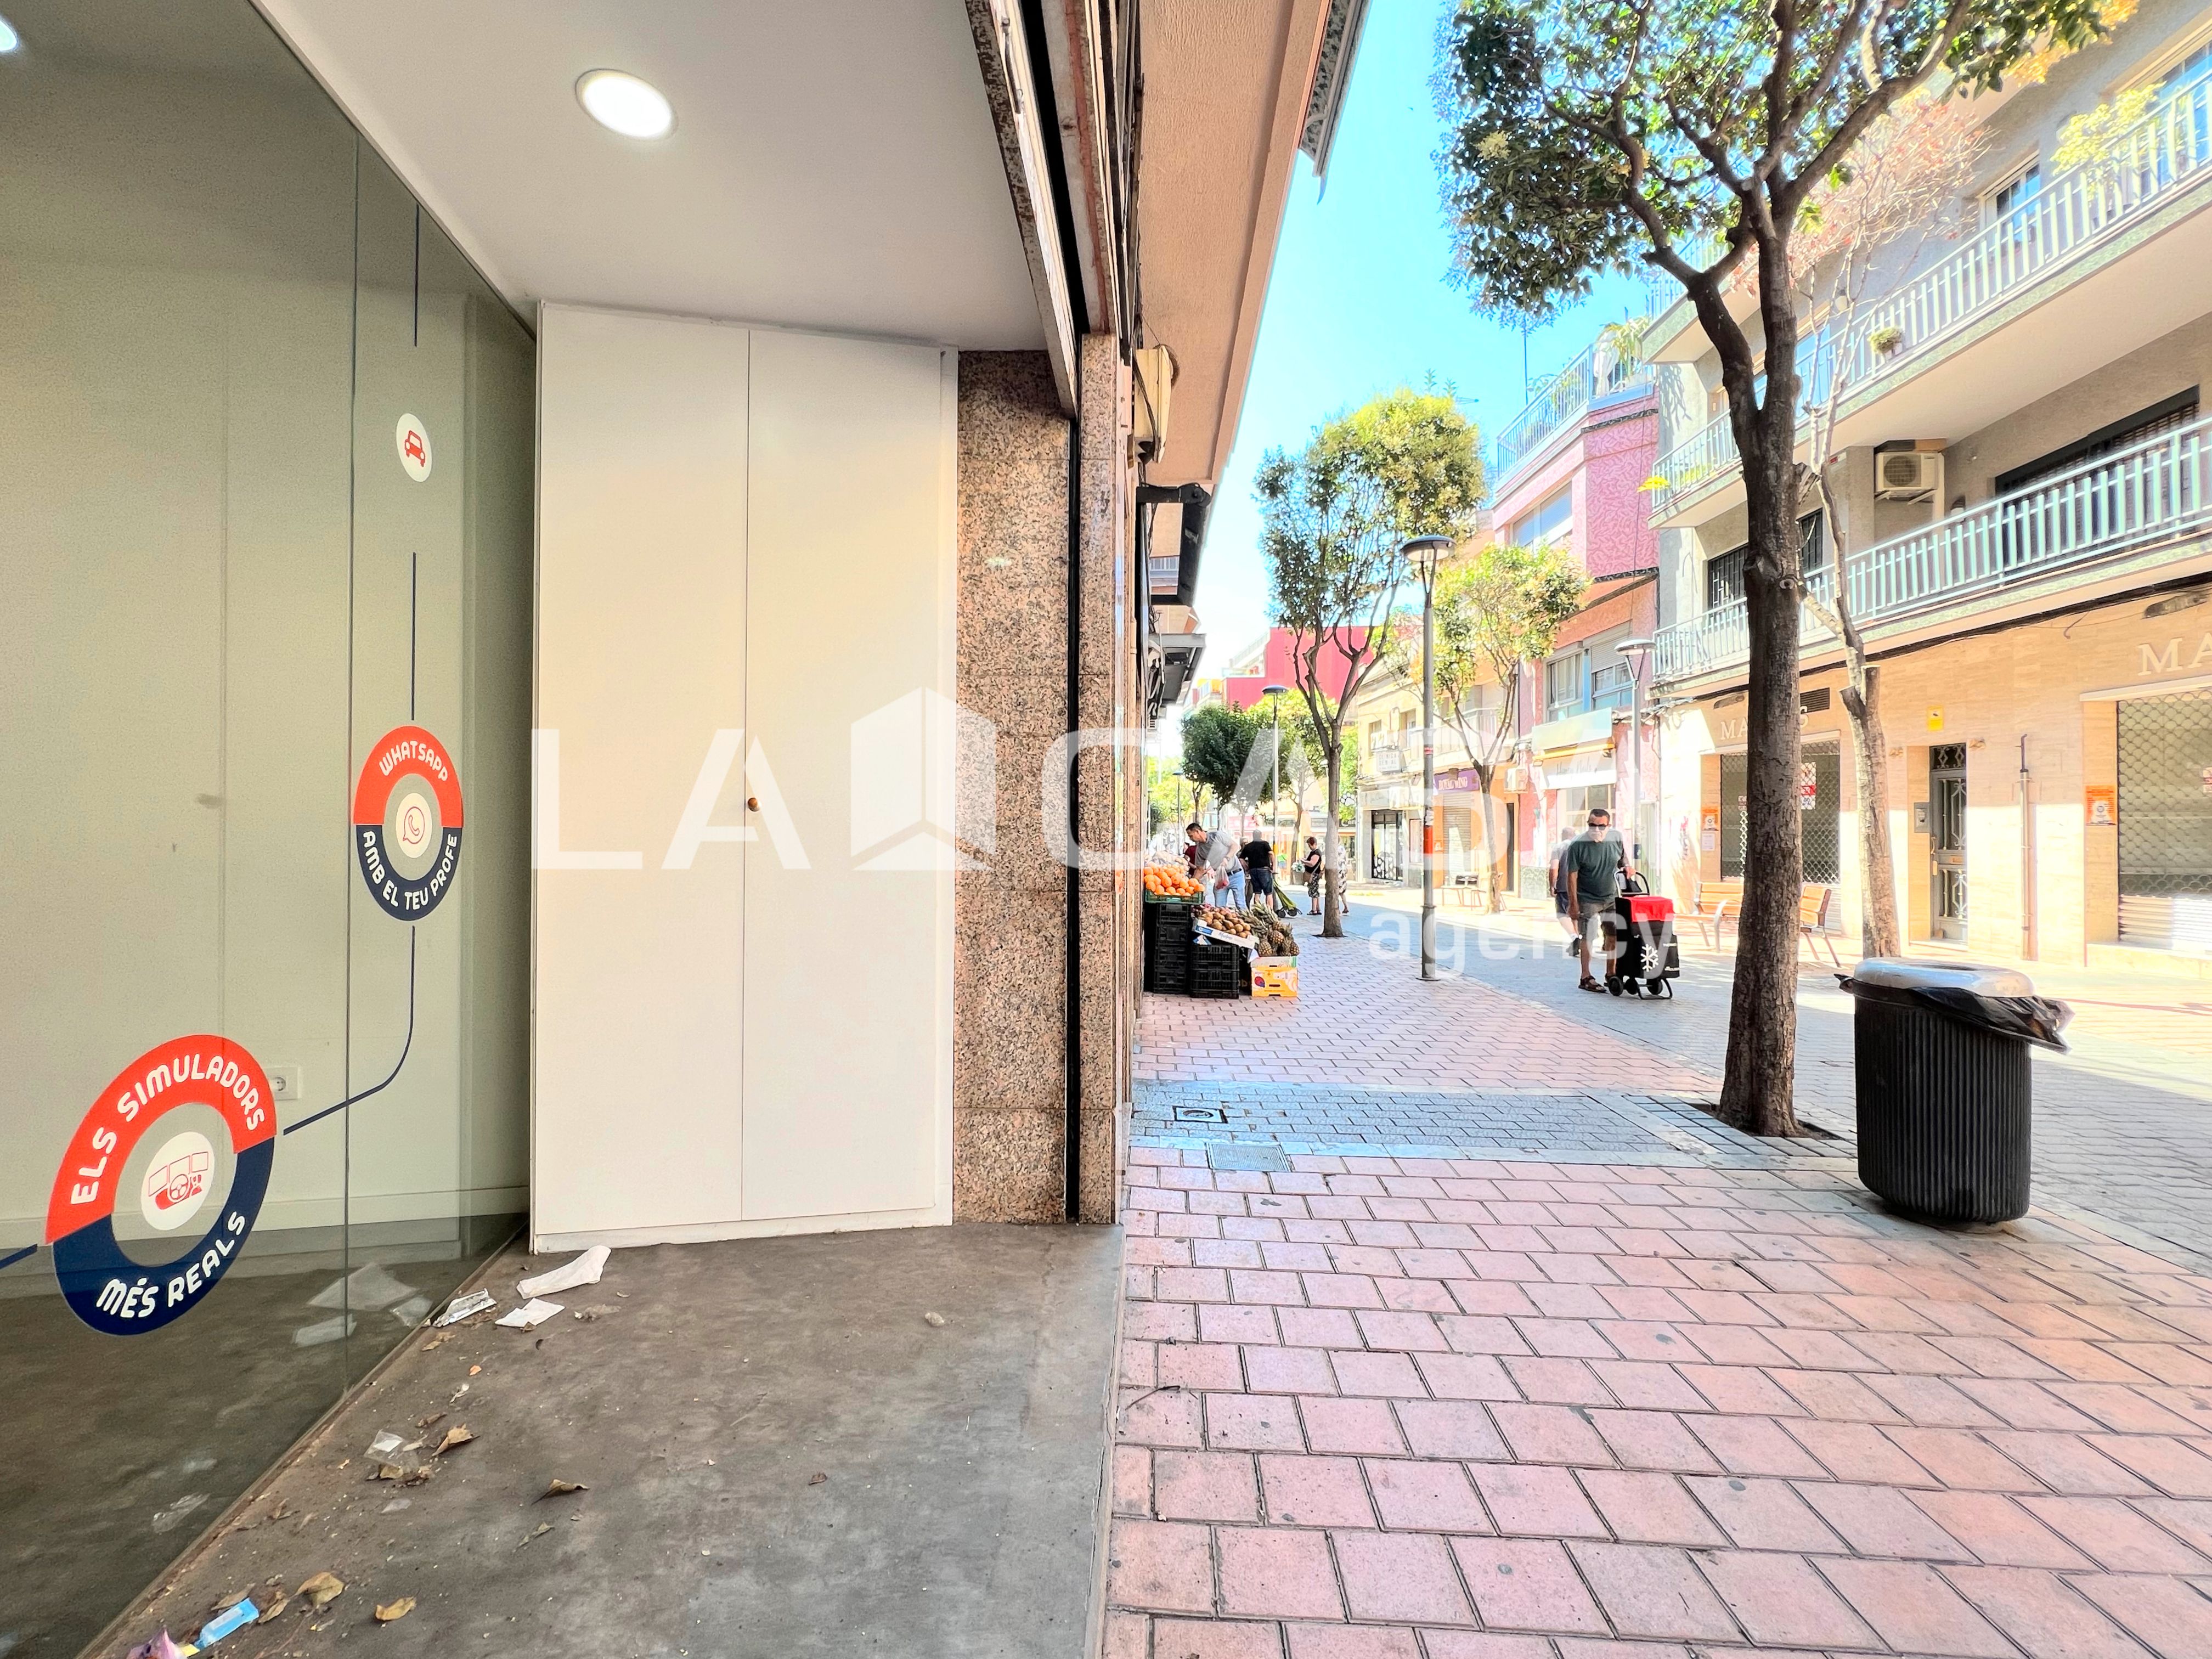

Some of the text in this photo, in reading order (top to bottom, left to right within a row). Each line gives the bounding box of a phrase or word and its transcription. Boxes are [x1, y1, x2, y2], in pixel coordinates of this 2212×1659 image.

[379, 740, 448, 781] WHATSAPP
[363, 831, 458, 910] AMB EL TEU PROFE
[71, 1054, 265, 1205] ELS SIMULADORS
[96, 1211, 245, 1318] MÉS REALS
